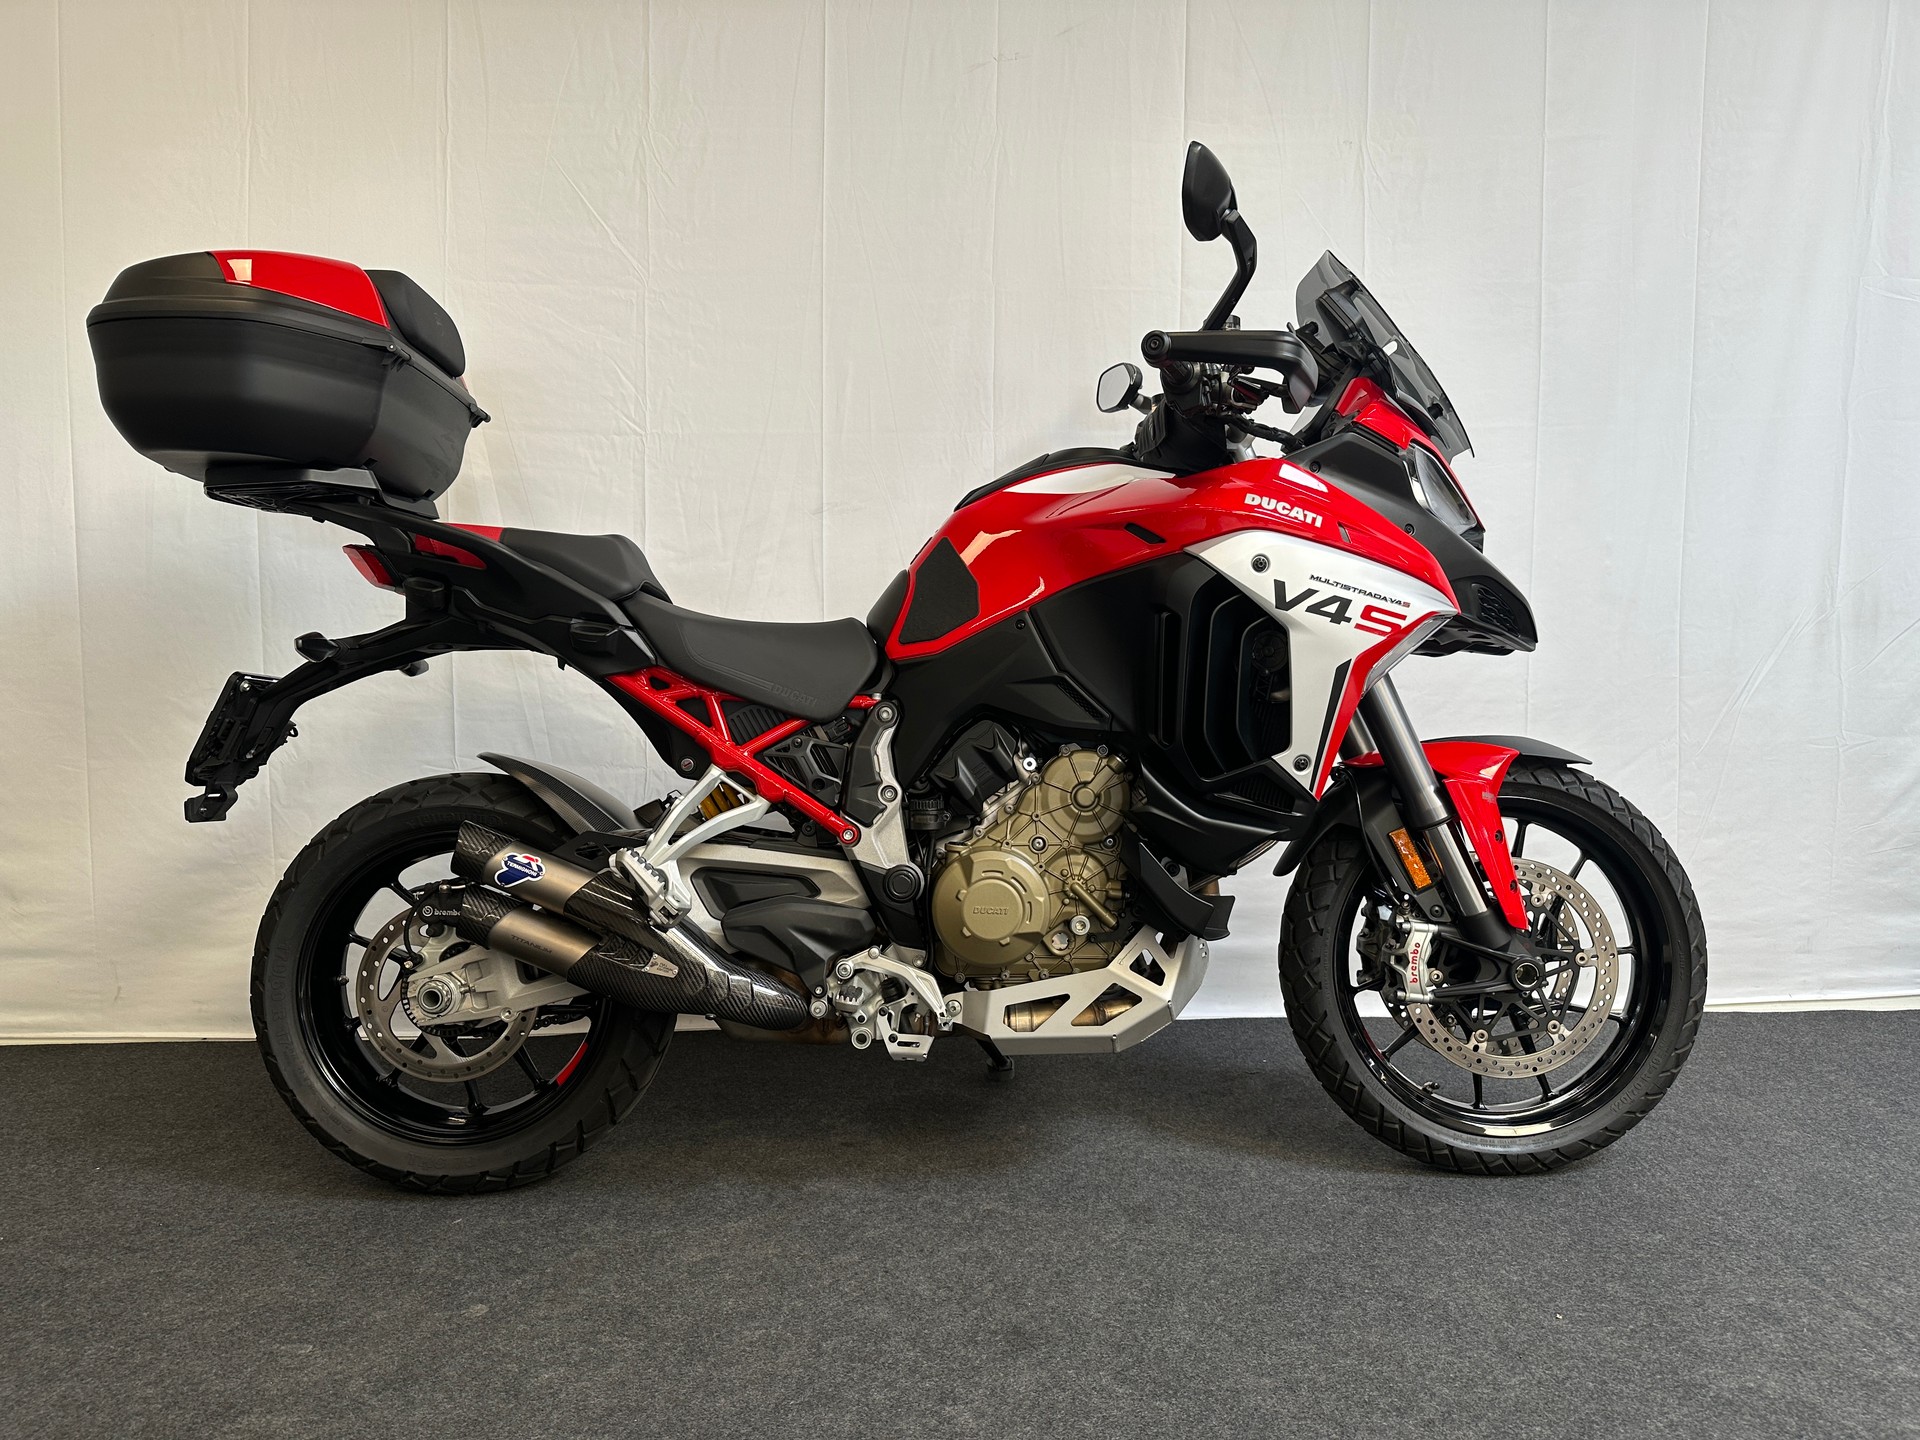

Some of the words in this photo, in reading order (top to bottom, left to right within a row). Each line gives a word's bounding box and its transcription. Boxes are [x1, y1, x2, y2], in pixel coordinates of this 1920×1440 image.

[1244, 493, 1323, 528] DUCATI
[1273, 578, 1407, 637] V4S
[770, 683, 817, 705] DUCATI
[506, 860, 538, 877] TERMIGNONI
[972, 905, 1009, 916] DUCATI
[511, 934, 553, 954] TITANIUM
[1409, 942, 1421, 984] brembo
